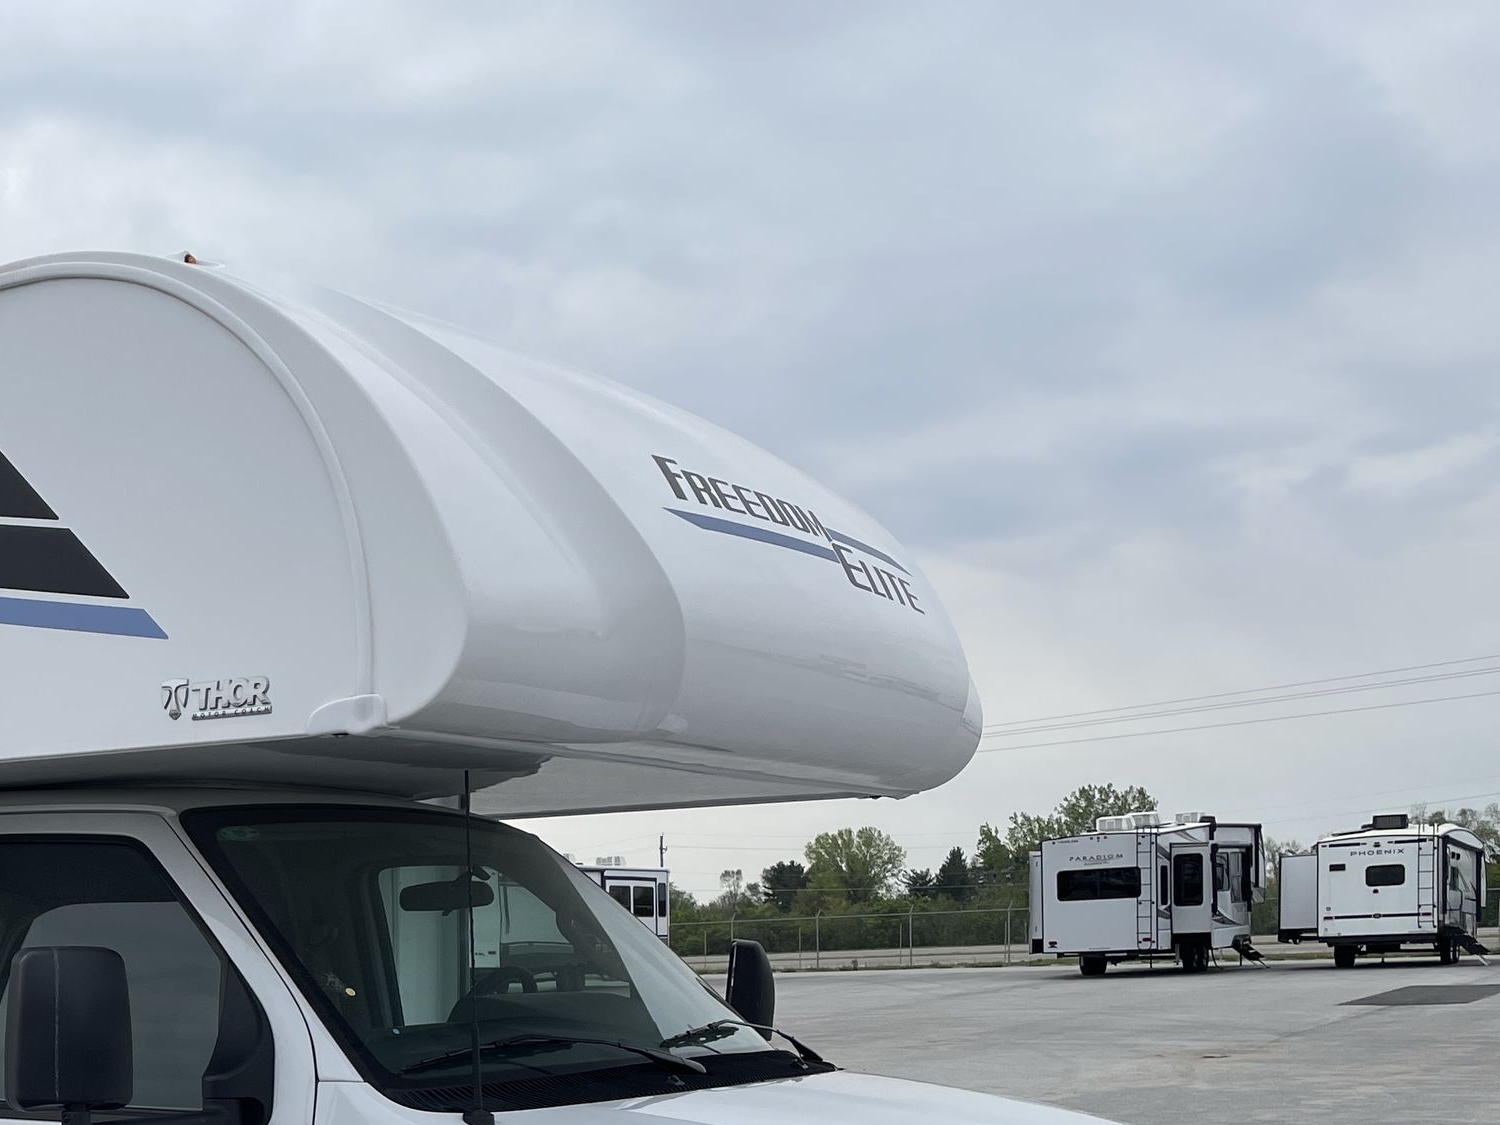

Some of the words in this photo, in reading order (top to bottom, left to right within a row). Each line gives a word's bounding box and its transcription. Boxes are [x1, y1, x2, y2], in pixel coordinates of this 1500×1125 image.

[651, 454, 833, 542] FREEDOM
[831, 542, 925, 615] ELITE
[192, 676, 271, 711] THOR
[1350, 848, 1404, 856] PHOENIX
